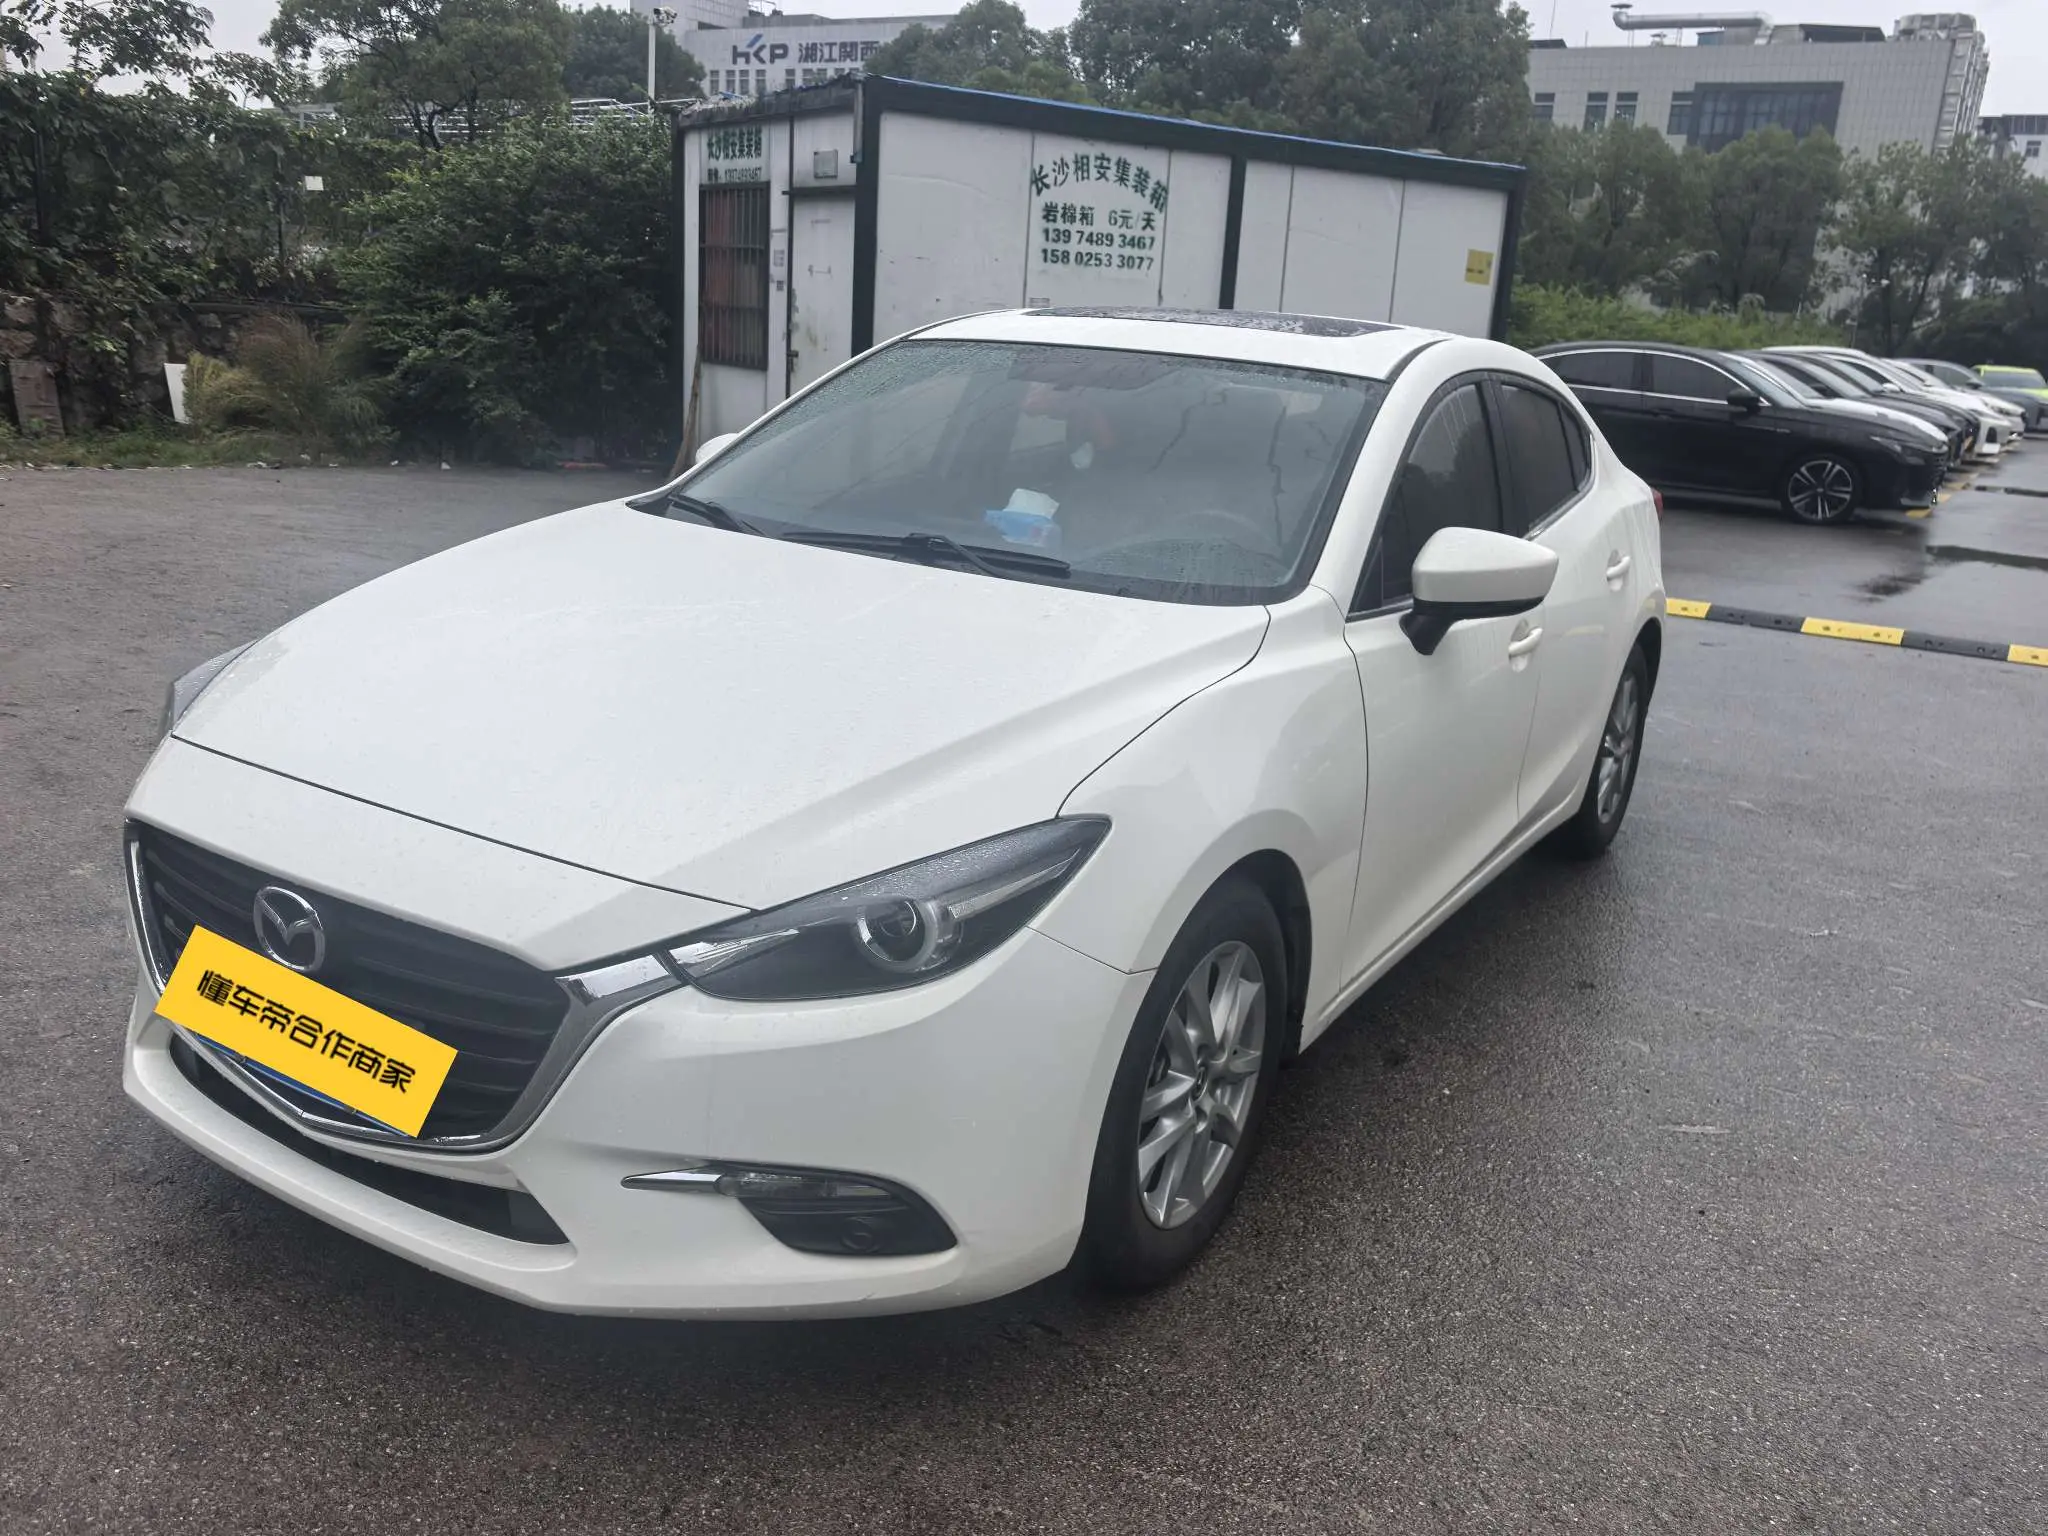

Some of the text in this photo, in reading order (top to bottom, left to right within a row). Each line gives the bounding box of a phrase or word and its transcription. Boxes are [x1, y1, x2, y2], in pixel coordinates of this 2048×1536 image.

[732, 33, 789, 65] HKP
[1031, 152, 1168, 214] 长沙相安集装箱
[1043, 228, 1156, 250] 139 7489 3467
[1042, 248, 1154, 271] 158 0253 3077
